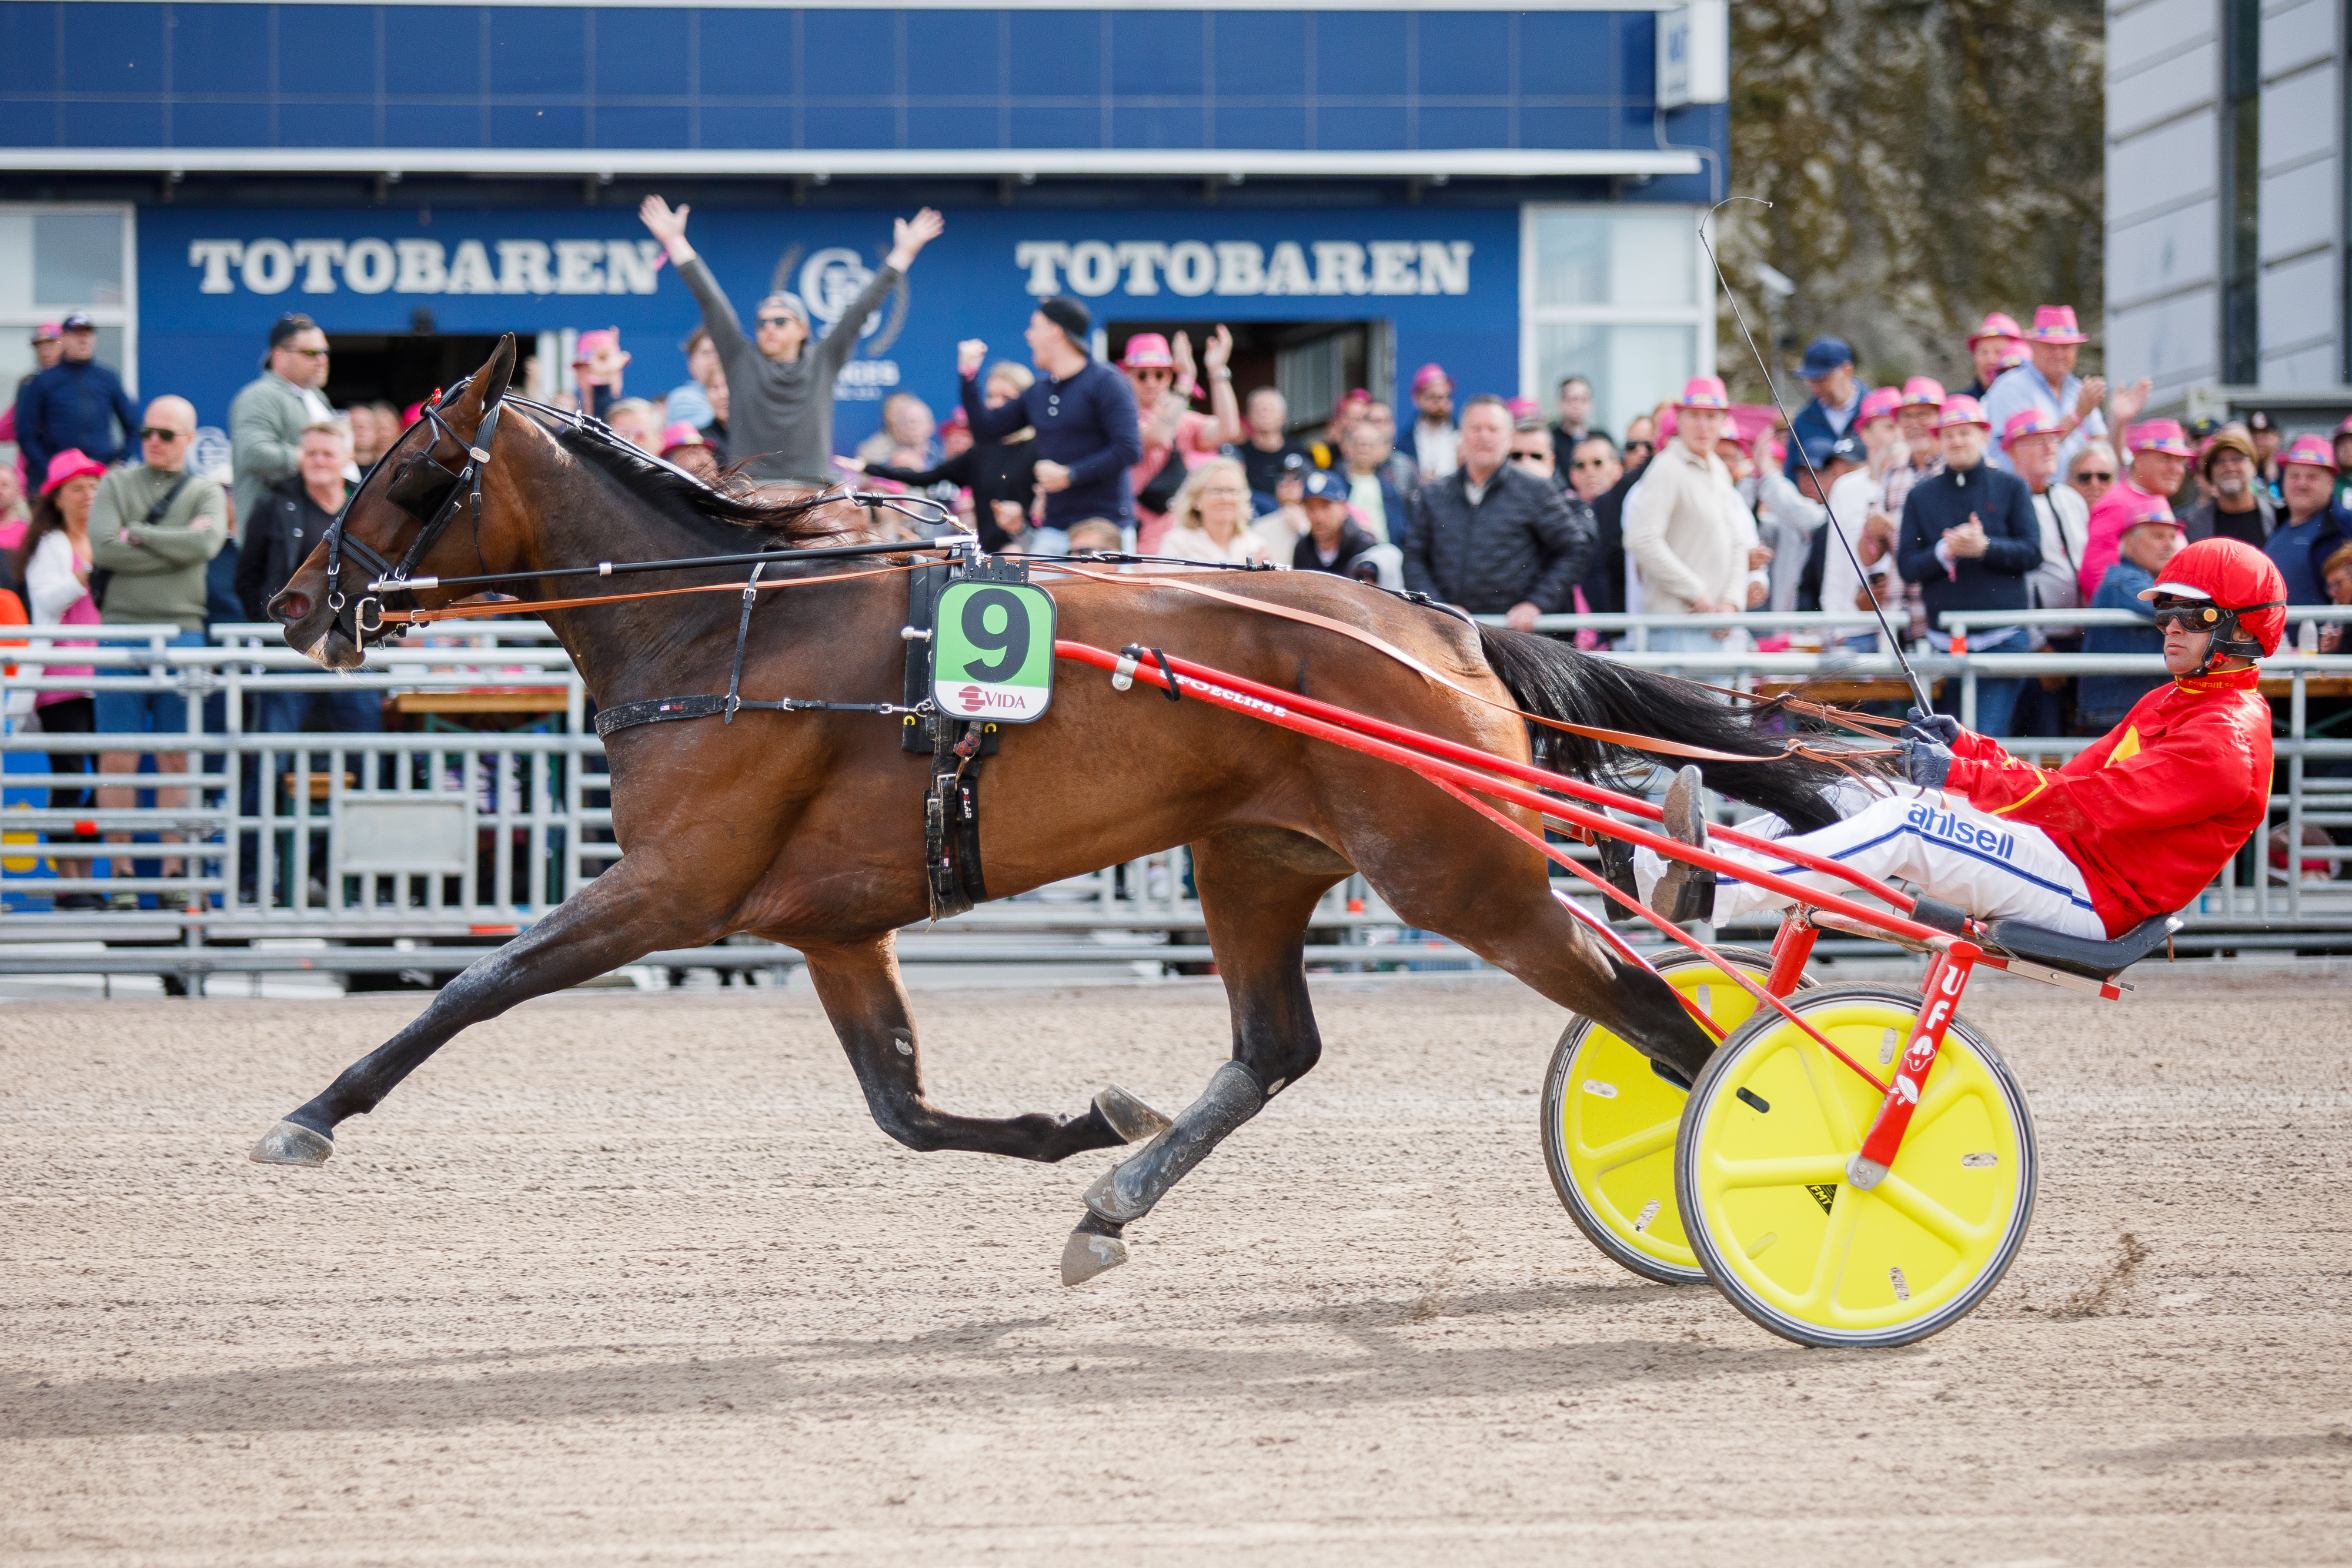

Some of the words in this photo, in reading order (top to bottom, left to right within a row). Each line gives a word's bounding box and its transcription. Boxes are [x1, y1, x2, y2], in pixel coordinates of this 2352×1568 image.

[189, 238, 659, 295] TOTOBAREN
[1015, 240, 1473, 296] TOTOBAREN
[961, 588, 1030, 683] 9
[984, 691, 1026, 709] VIDA
[1210, 684, 1286, 717] ECLIPSE
[2188, 680, 2234, 688] courant.se
[962, 787, 972, 818] POLAR
[1908, 803, 2014, 860] ahlsell
[1810, 1185, 1833, 1205] FMT
